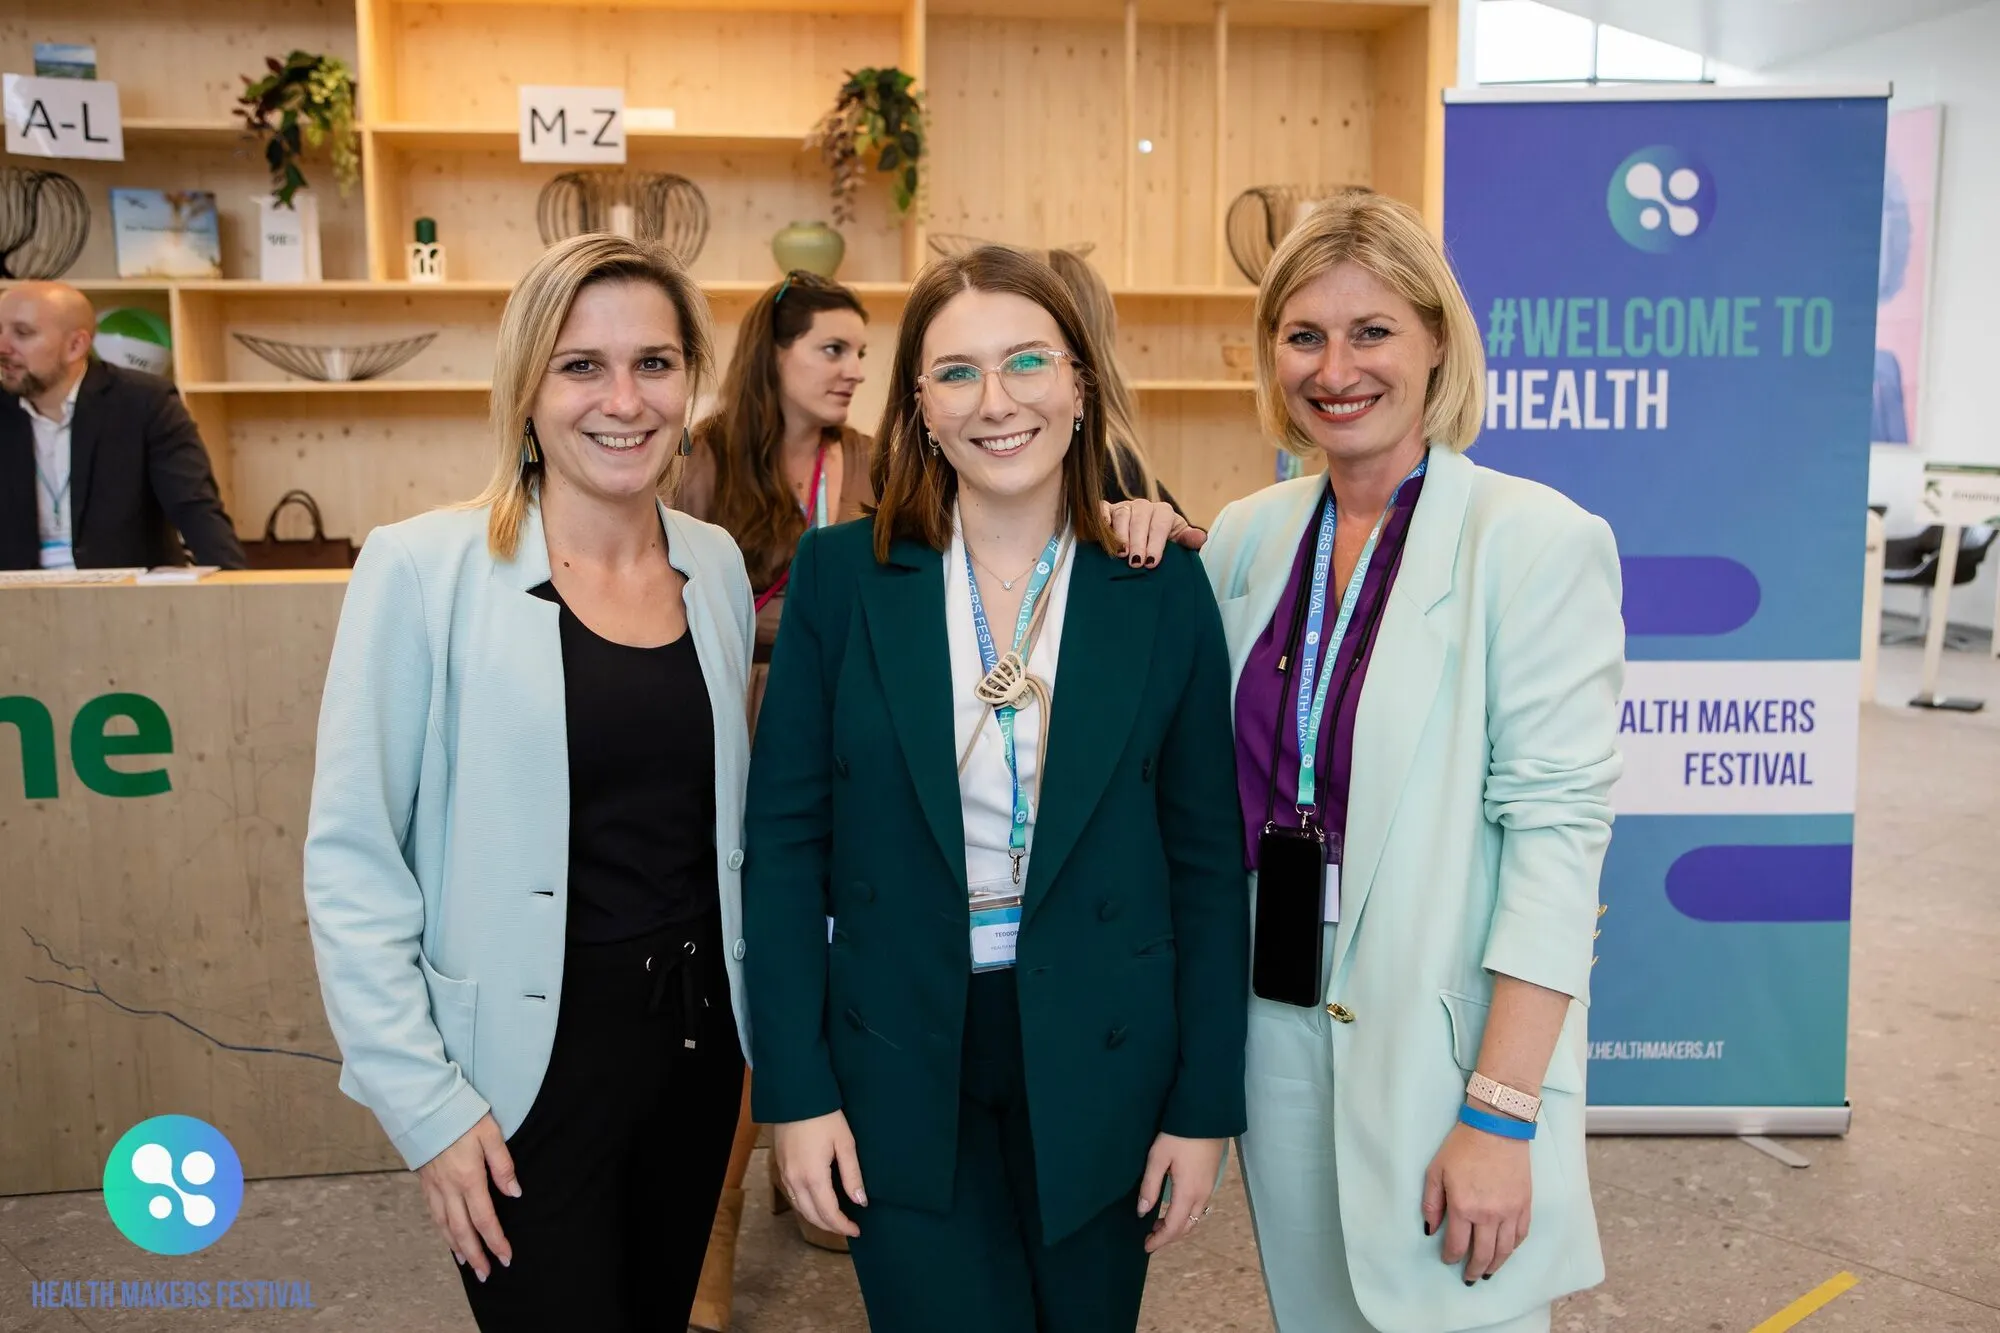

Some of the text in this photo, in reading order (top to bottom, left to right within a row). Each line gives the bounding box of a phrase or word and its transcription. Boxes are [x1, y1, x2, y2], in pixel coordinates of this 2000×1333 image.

[21, 99, 109, 142] A-L
[530, 106, 619, 147] M-Z
[1487, 297, 1834, 358] #WELCOME TO
[1485, 369, 1669, 430] HEALTH
[1310, 501, 1336, 618] MAKERS FESTIVAL
[973, 615, 998, 669] FESTIVA
[1307, 554, 1371, 741] HEALTH MAKERS FESTIVAL
[1299, 657, 1314, 712] HEALTH
[1616, 699, 1815, 733] ALTH MAKERS
[1684, 751, 1813, 786] FESTIVAL
